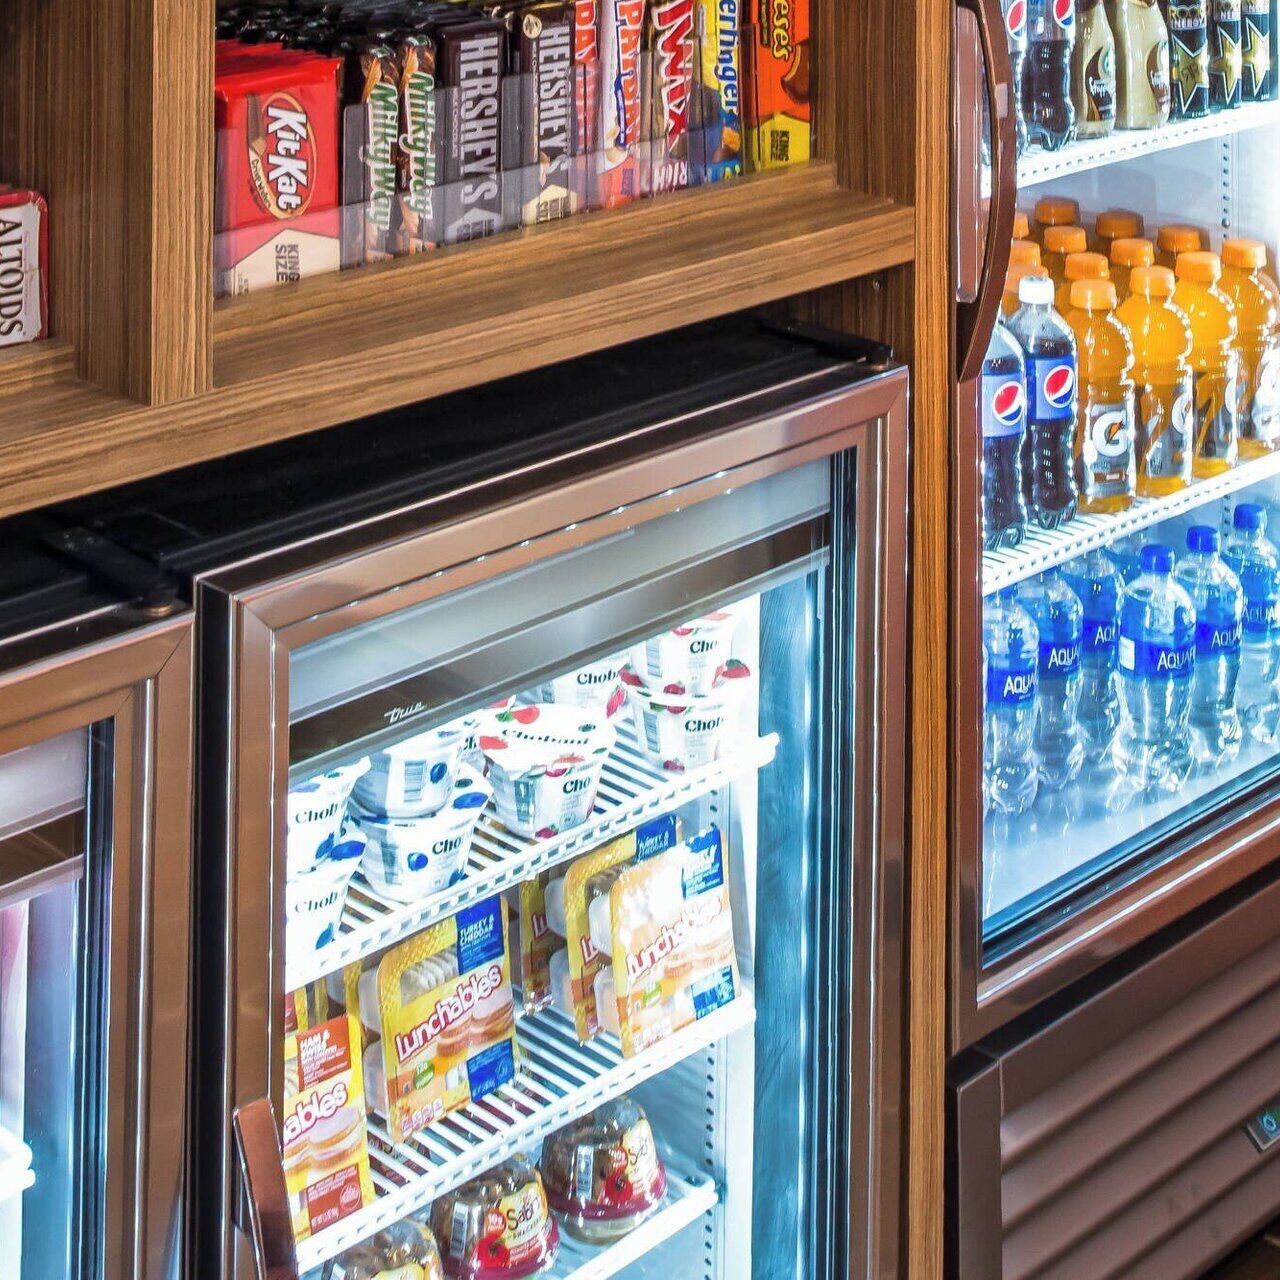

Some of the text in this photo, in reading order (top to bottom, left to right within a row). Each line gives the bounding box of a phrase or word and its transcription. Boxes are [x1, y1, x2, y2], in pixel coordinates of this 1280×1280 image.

[275, 243, 289, 283] SIZE
[288, 243, 300, 282] KING
[395, 965, 503, 1063] Lunchables
